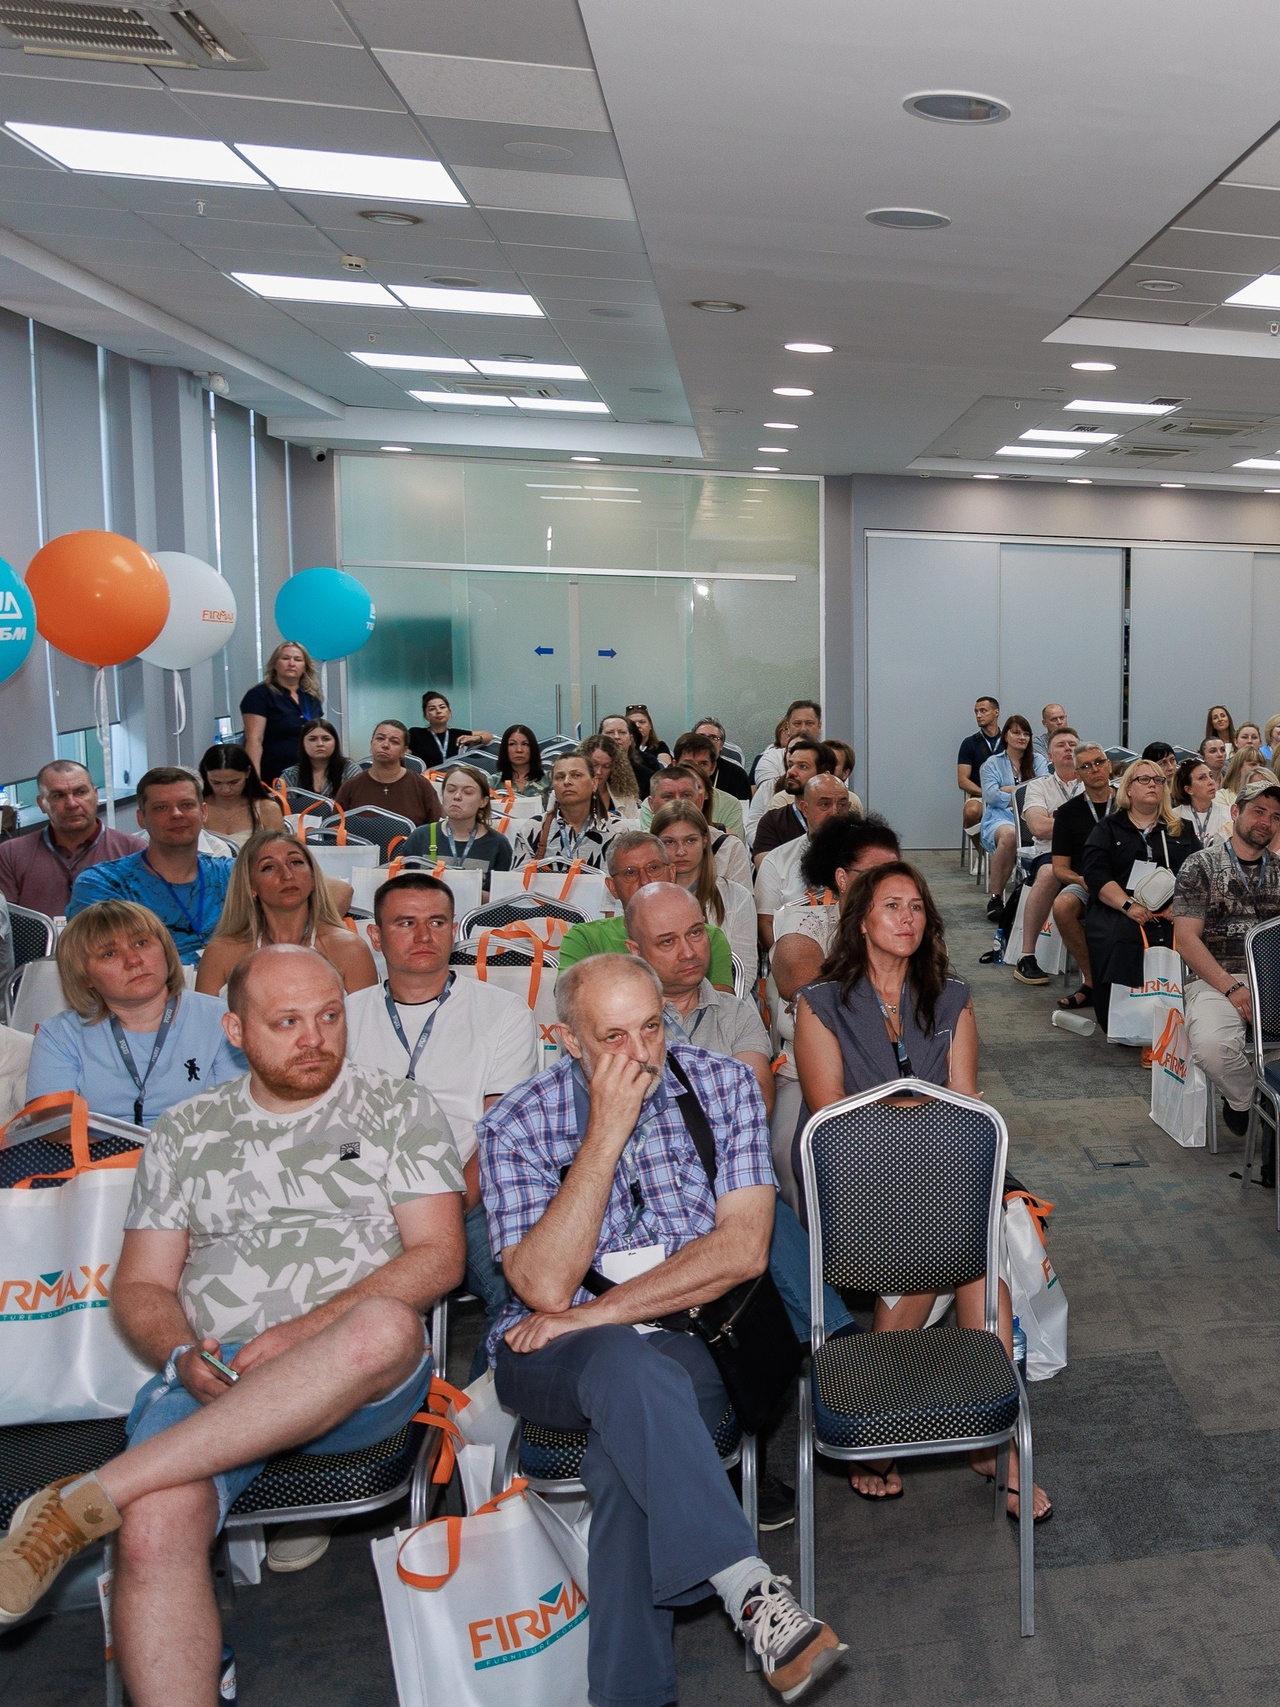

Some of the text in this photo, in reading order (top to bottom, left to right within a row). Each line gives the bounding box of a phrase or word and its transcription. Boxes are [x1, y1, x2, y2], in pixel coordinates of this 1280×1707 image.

[0, 627, 27, 641] БМ
[0, 1264, 111, 1312] RMAX
[468, 1576, 588, 1660] FIRMA
[485, 1638, 552, 1667] FURNITURE
